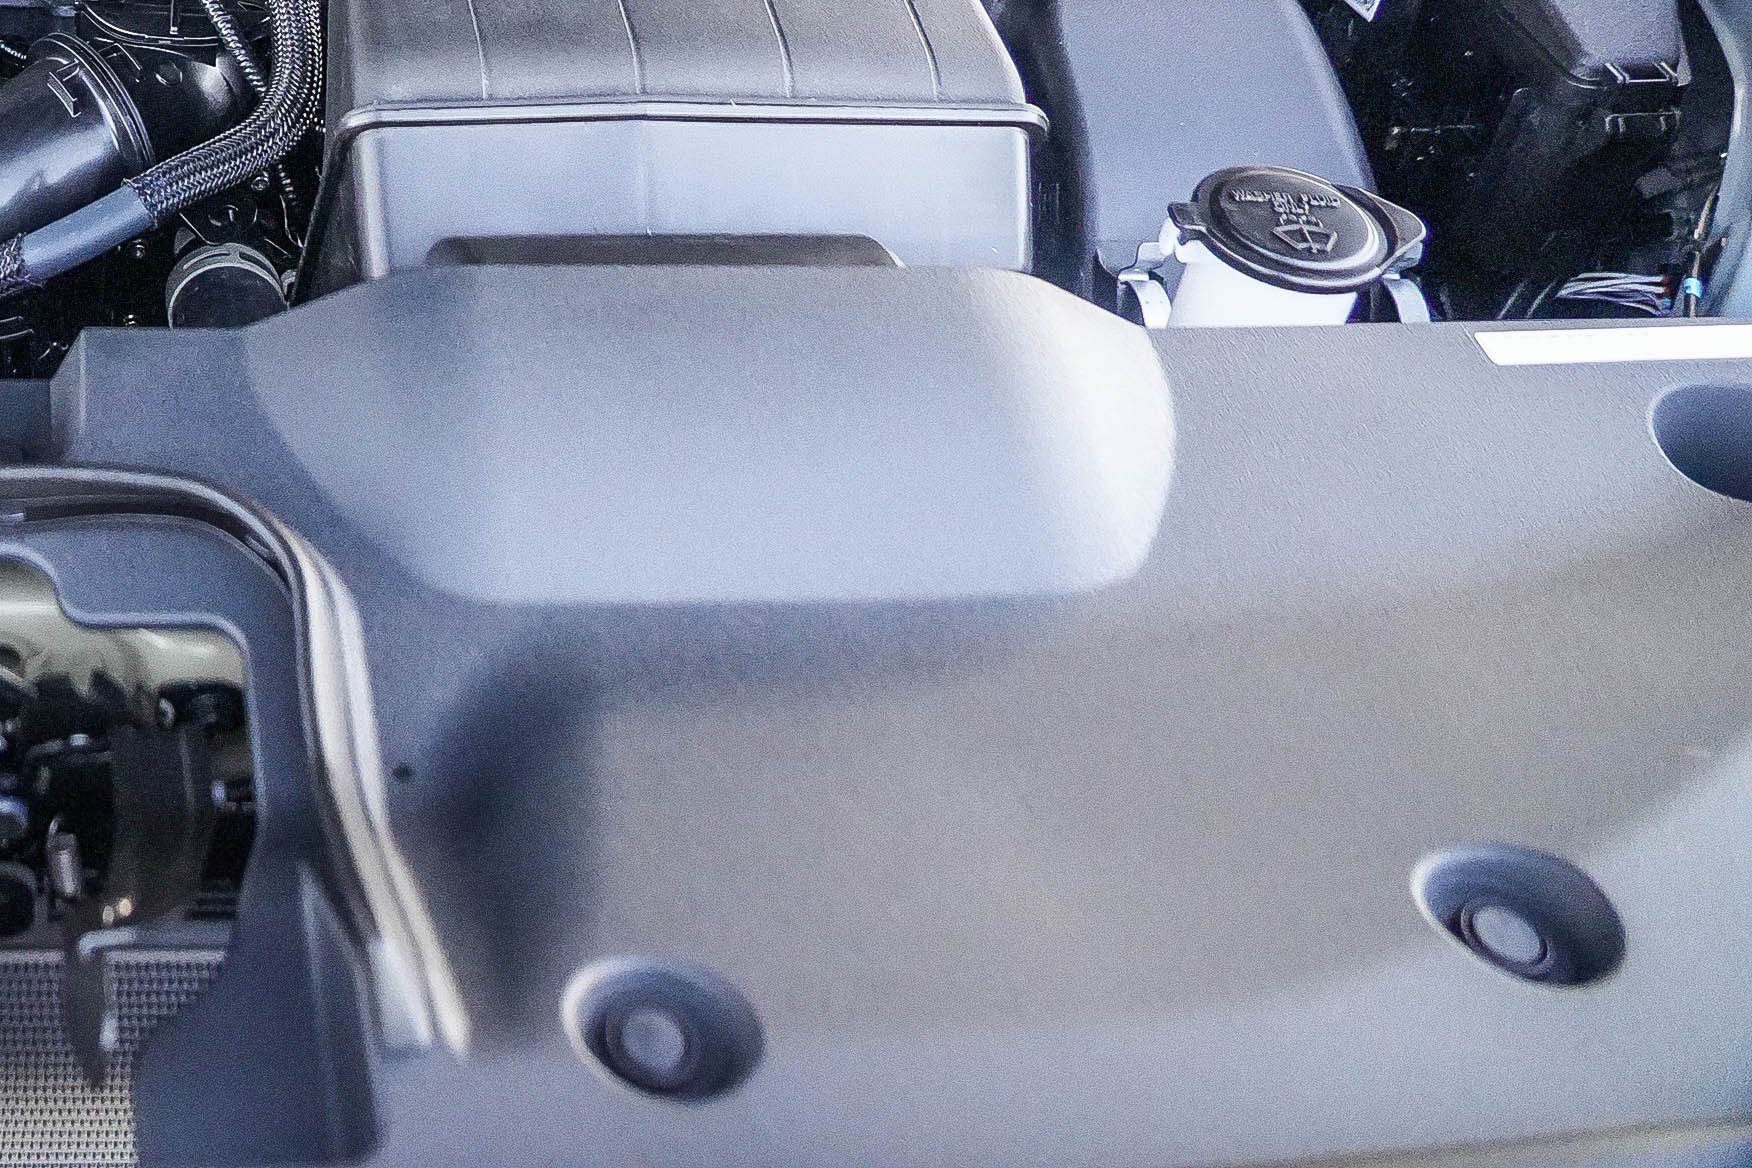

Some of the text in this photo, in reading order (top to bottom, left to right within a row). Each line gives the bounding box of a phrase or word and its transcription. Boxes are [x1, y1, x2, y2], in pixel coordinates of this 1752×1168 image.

[1231, 187, 1341, 209] WASHER FLUID
[1272, 198, 1310, 215] ONLY
